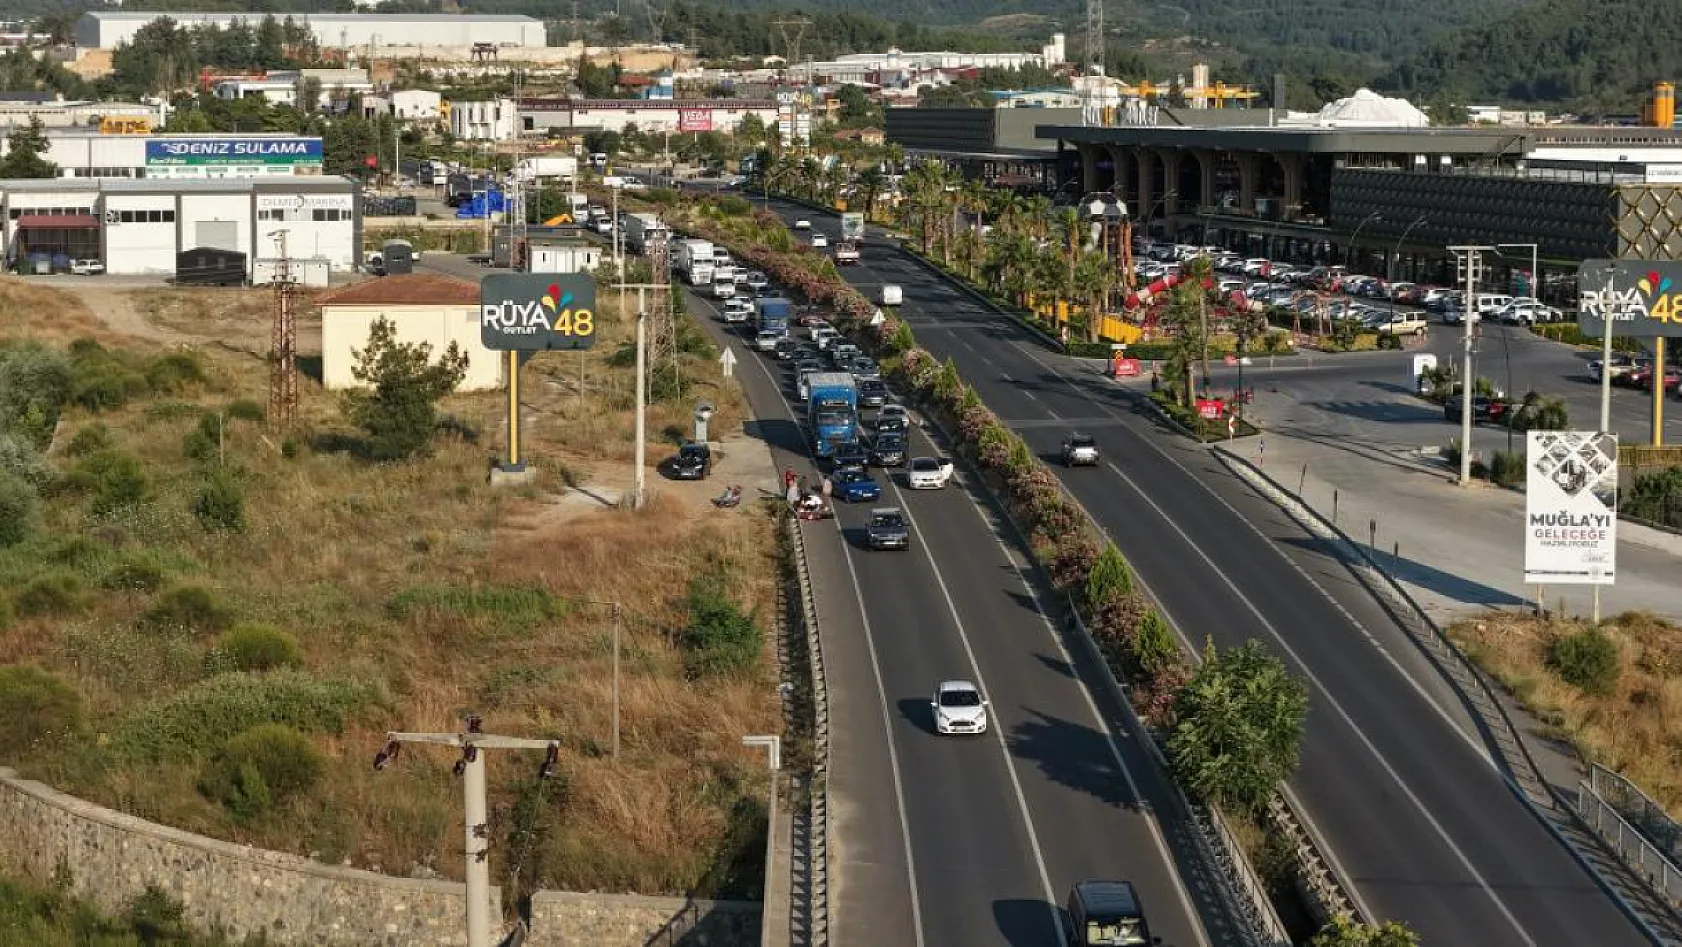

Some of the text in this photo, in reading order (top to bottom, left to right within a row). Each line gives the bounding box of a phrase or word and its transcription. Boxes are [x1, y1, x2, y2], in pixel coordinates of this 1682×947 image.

[234, 142, 307, 154] SULAMA
[483, 299, 595, 336] RÜYA 48
[502, 326, 537, 335] OUTLET
[1529, 509, 1610, 527] MUĞLA'YI
